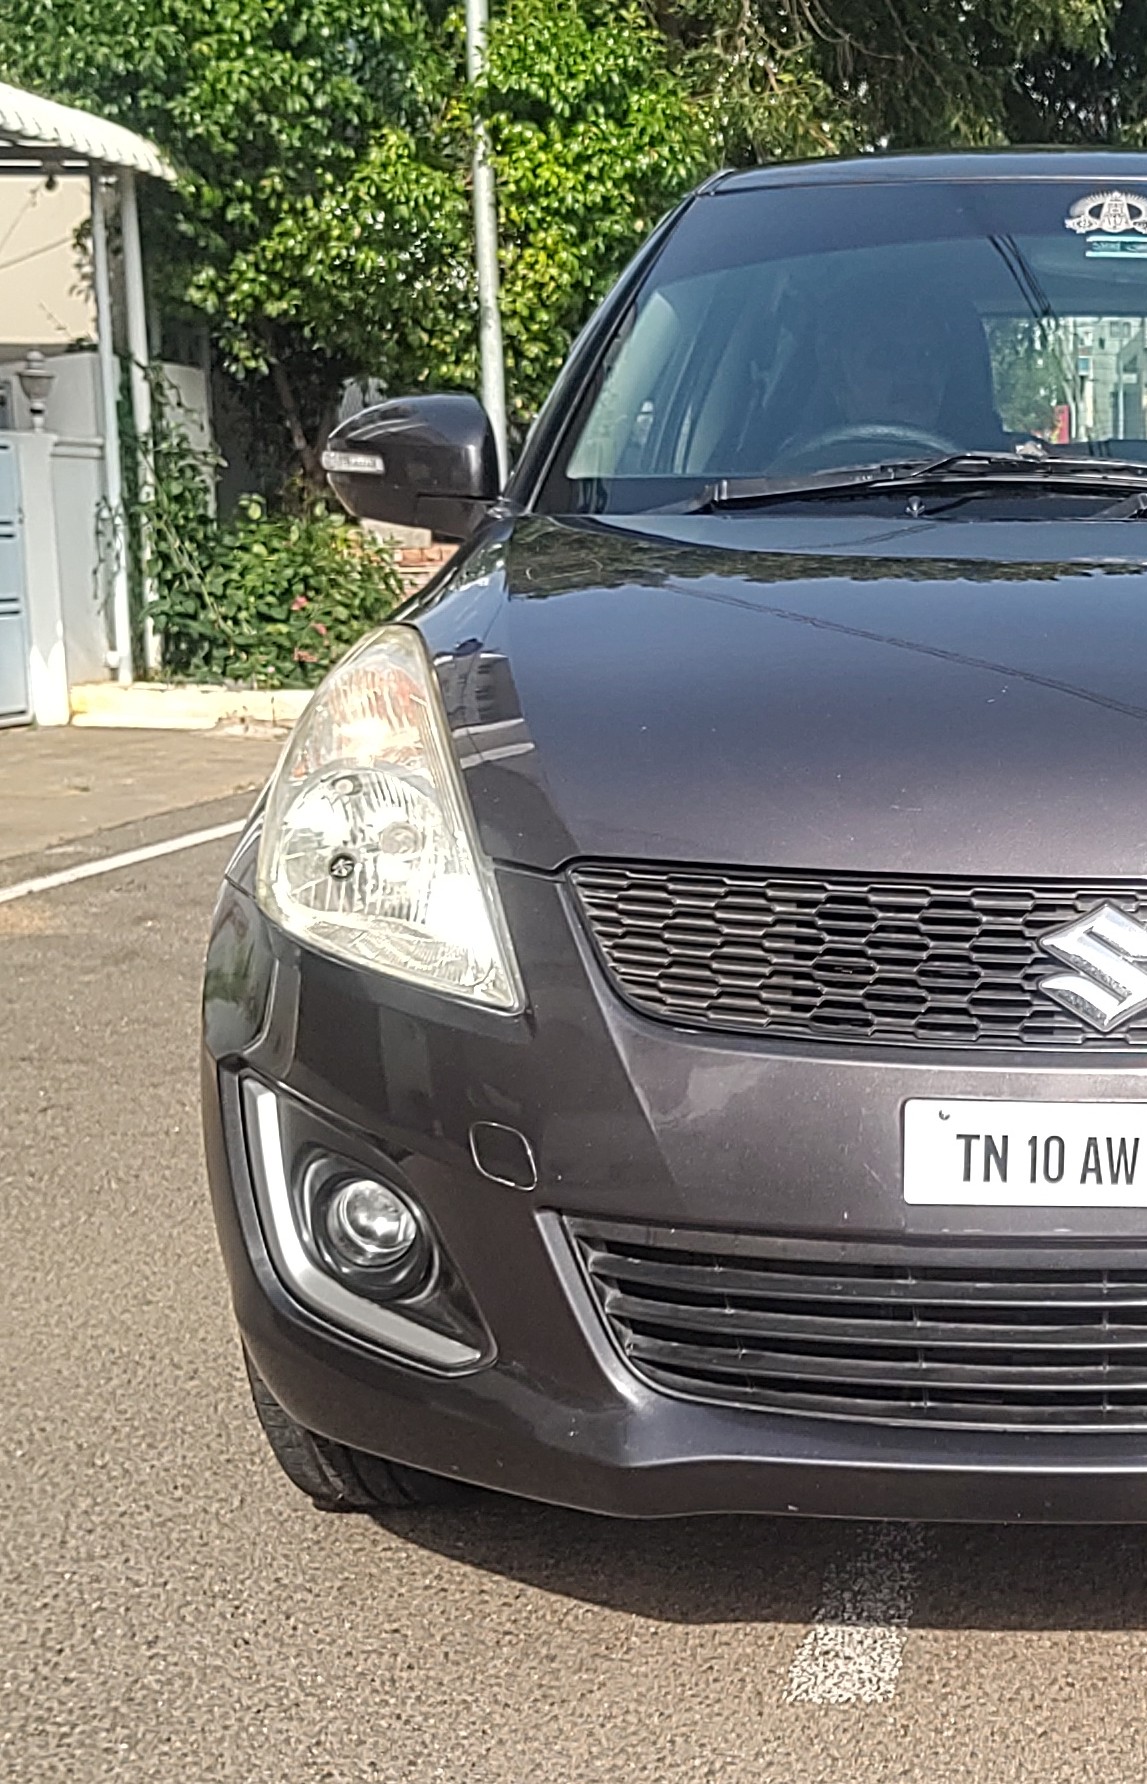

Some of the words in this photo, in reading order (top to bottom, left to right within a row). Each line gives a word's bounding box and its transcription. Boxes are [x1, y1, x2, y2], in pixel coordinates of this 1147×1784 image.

[955, 1133, 1009, 1184] TN
[1027, 1134, 1066, 1184] 10
[1079, 1136, 1140, 1186] AW
